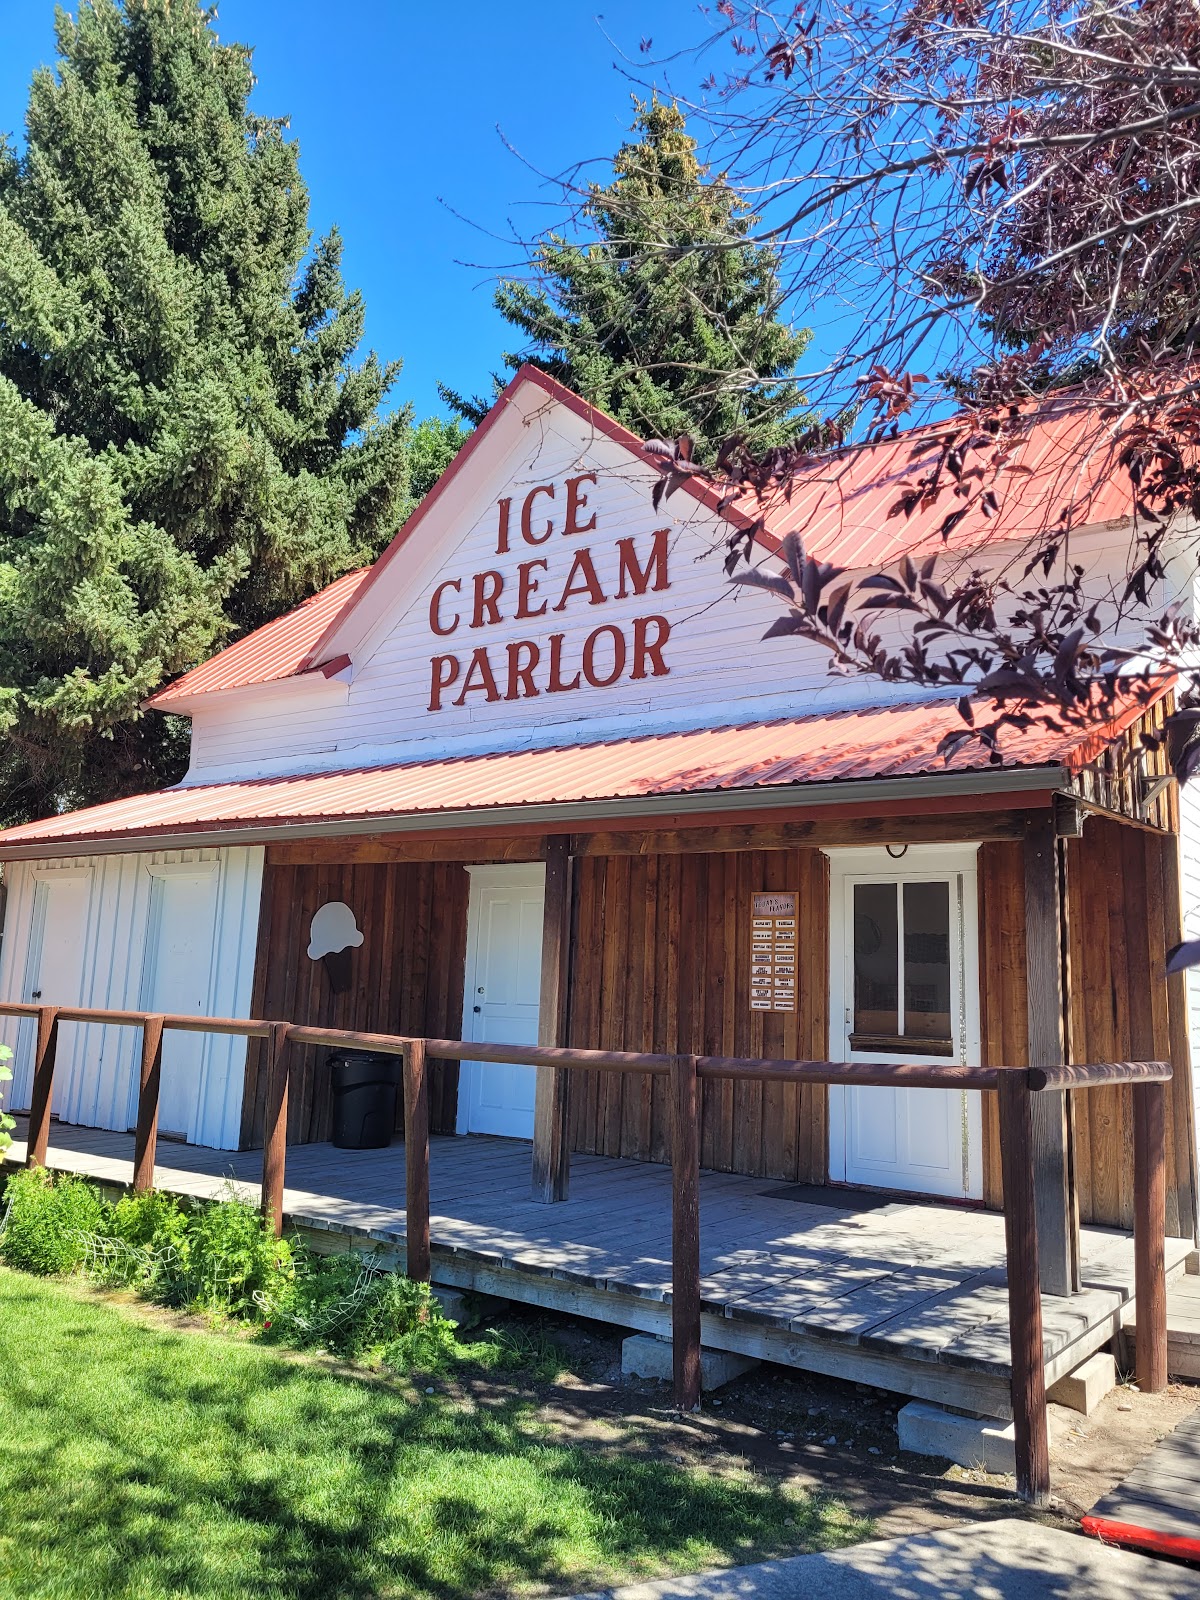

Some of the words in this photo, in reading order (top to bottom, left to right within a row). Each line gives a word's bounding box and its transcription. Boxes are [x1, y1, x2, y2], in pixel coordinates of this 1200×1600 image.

[494, 472, 597, 555] ICE
[429, 528, 672, 636] CREAM
[427, 615, 671, 711] PARLOR
[769, 902, 794, 912] FLAVORS
